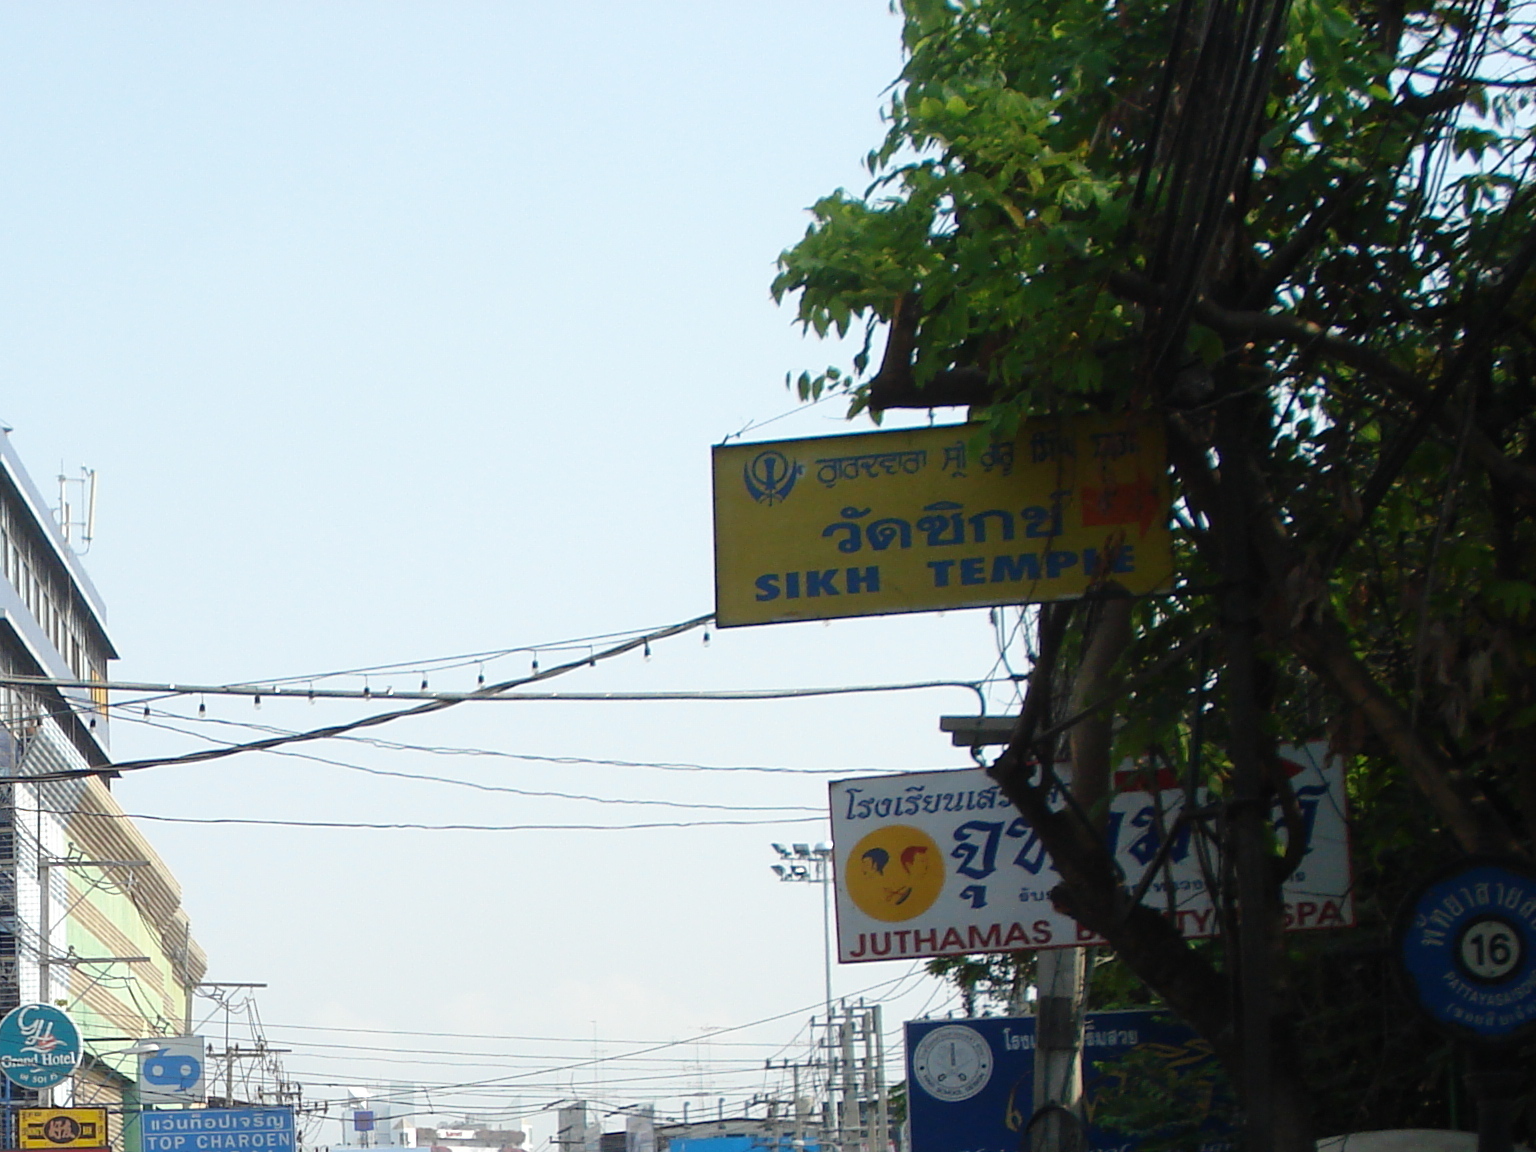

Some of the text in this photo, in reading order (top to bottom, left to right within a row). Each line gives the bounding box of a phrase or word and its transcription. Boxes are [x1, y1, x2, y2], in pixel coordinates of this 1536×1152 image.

[822, 489, 1072, 554] วัดซิกข์
[754, 544, 1136, 602] SIKH TEMPLE
[850, 918, 1053, 960] JUTHAMAS
[1470, 933, 1512, 967] 16
[1, 1051, 76, 1069] Grand Hotel
[150, 1113, 285, 1131] แว่นท็อปเจริญ
[146, 1132, 291, 1151] TOP CHAROEN
